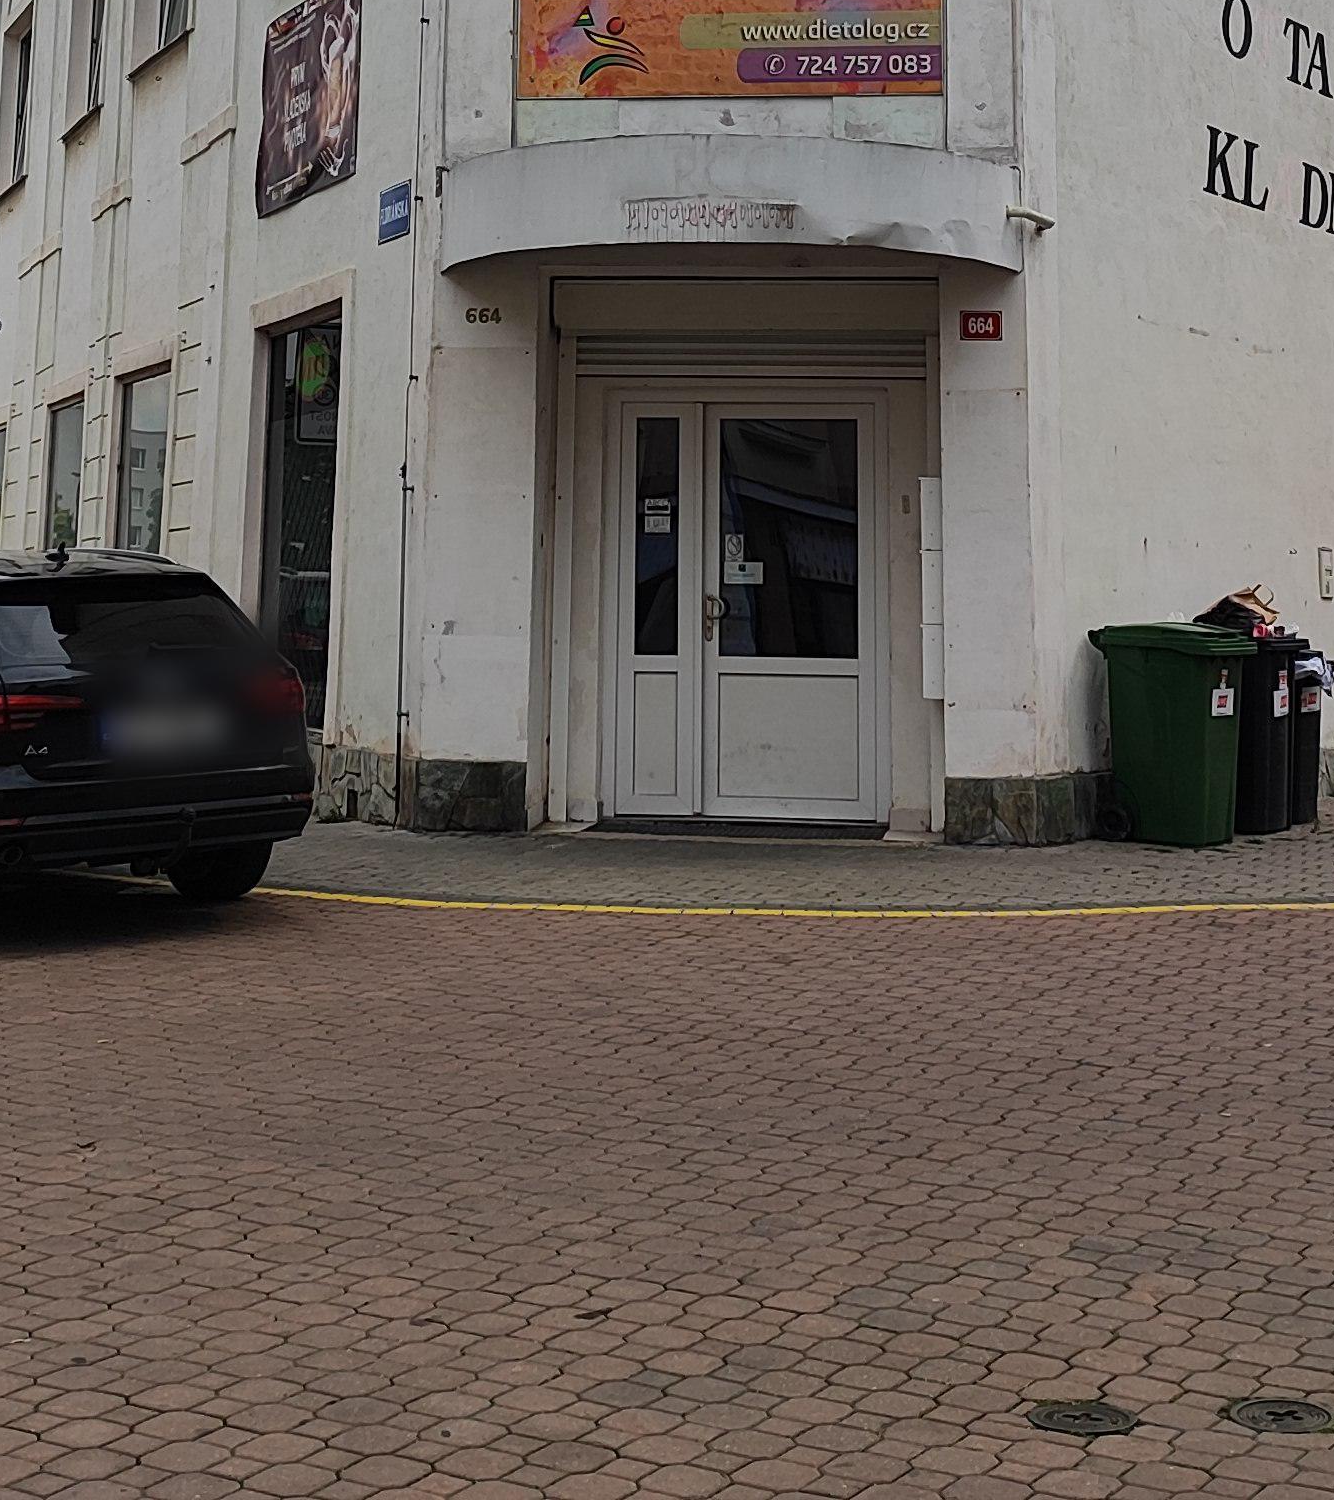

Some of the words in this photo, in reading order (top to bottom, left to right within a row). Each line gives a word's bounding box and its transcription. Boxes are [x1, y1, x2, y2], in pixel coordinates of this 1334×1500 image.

[741, 18, 931, 44] www.dietolog.cz
[797, 56, 838, 75] 724
[842, 55, 882, 74] 757
[887, 53, 932, 74] 083
[465, 307, 502, 324] 664
[968, 317, 995, 334] 664
[24, 744, 48, 756] A4
